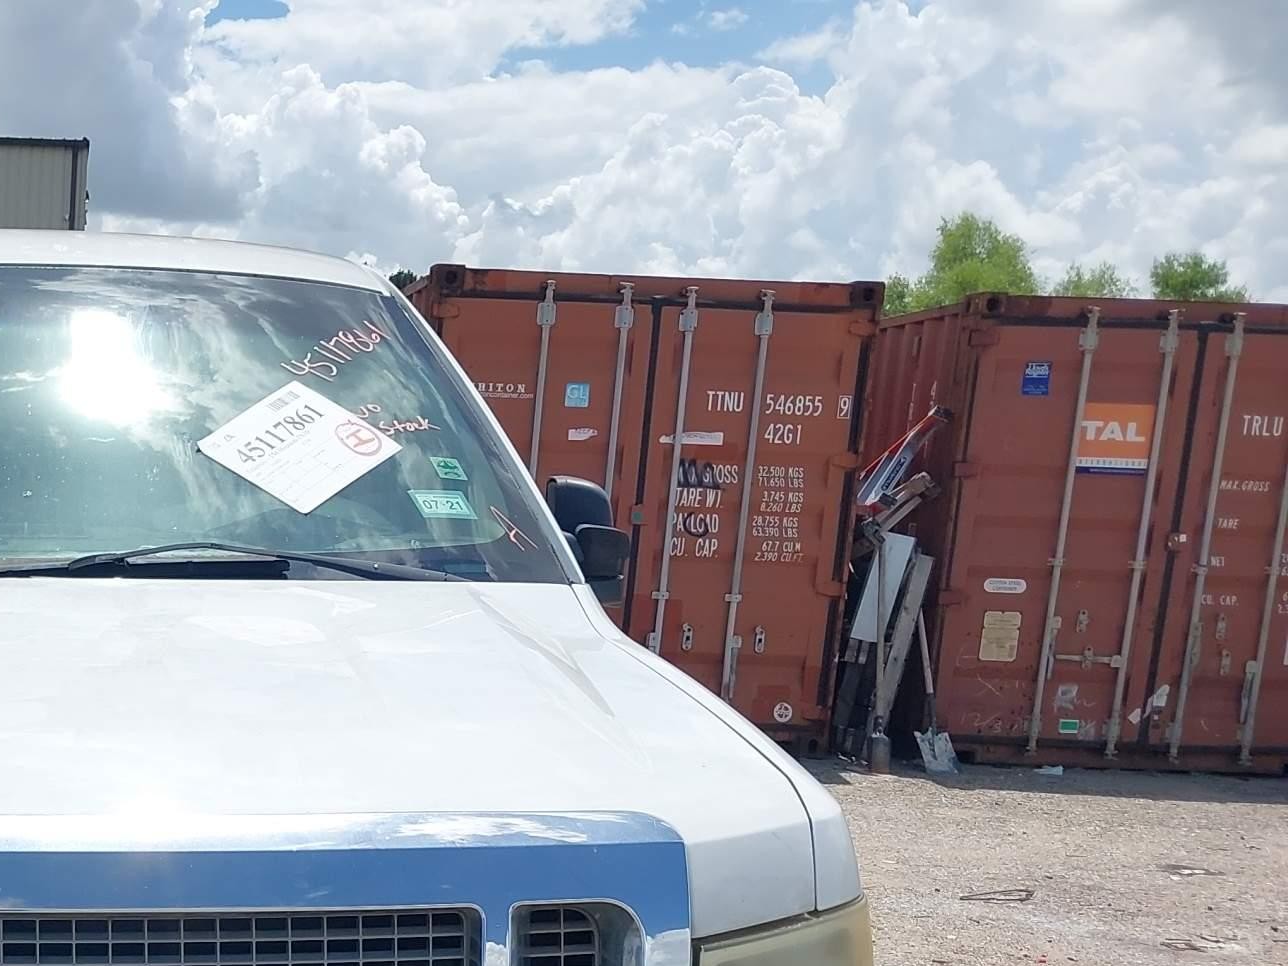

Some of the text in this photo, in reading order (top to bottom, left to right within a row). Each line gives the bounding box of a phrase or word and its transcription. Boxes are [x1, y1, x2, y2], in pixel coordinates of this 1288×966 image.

[473, 382, 526, 393] RITON
[707, 391, 850, 418] TTNU 546855 9
[236, 404, 325, 463] 45117861
[764, 423, 803, 445] 42G1
[1081, 420, 1145, 442] TAL
[1243, 415, 1284, 437] TRLU
[788, 467, 804, 478] KGS
[788, 478, 804, 488] LBS
[674, 487, 704, 508] TARE
[787, 492, 804, 503] KGS
[785, 503, 803, 513] LBS
[672, 512, 719, 533] PALOAD
[783, 516, 799, 527] KGS
[1217, 518, 1240, 529] TARE
[783, 528, 798, 538] LBS
[670, 537, 718, 558] CU. CAP.
